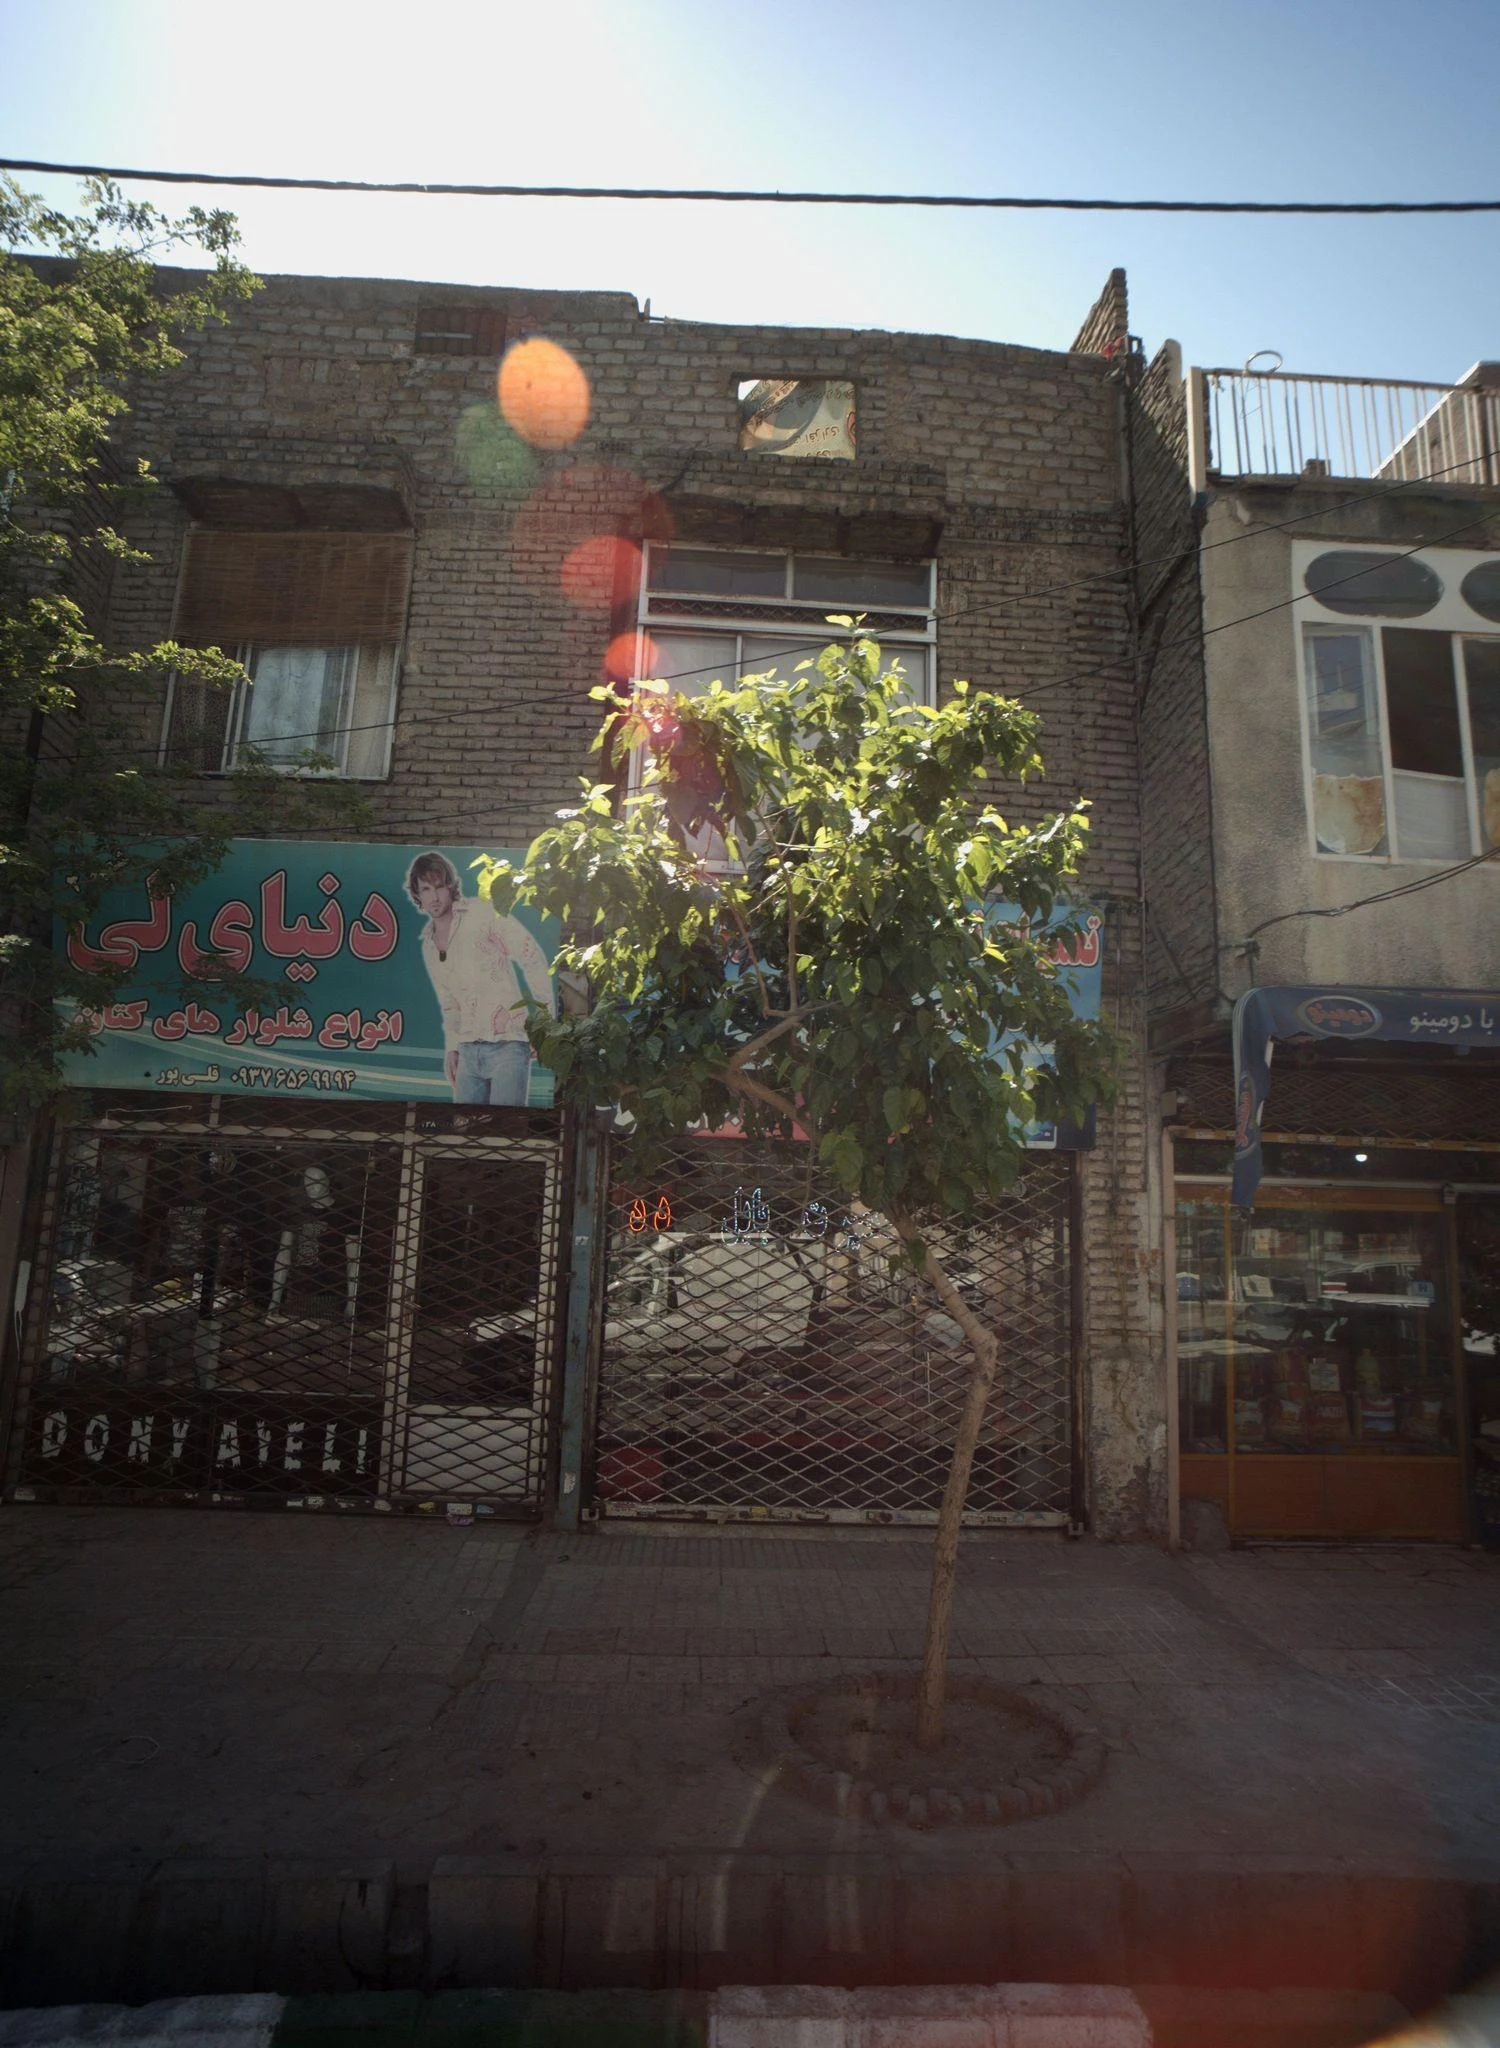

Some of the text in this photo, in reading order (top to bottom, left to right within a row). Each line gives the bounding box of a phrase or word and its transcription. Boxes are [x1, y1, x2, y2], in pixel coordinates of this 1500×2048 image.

[66, 867, 400, 983] دنیای لی
[152, 1001, 222, 1042] های
[223, 1005, 314, 1047] شلوار
[318, 1008, 405, 1051] انواع
[1409, 1007, 1494, 1036] با دومینو
